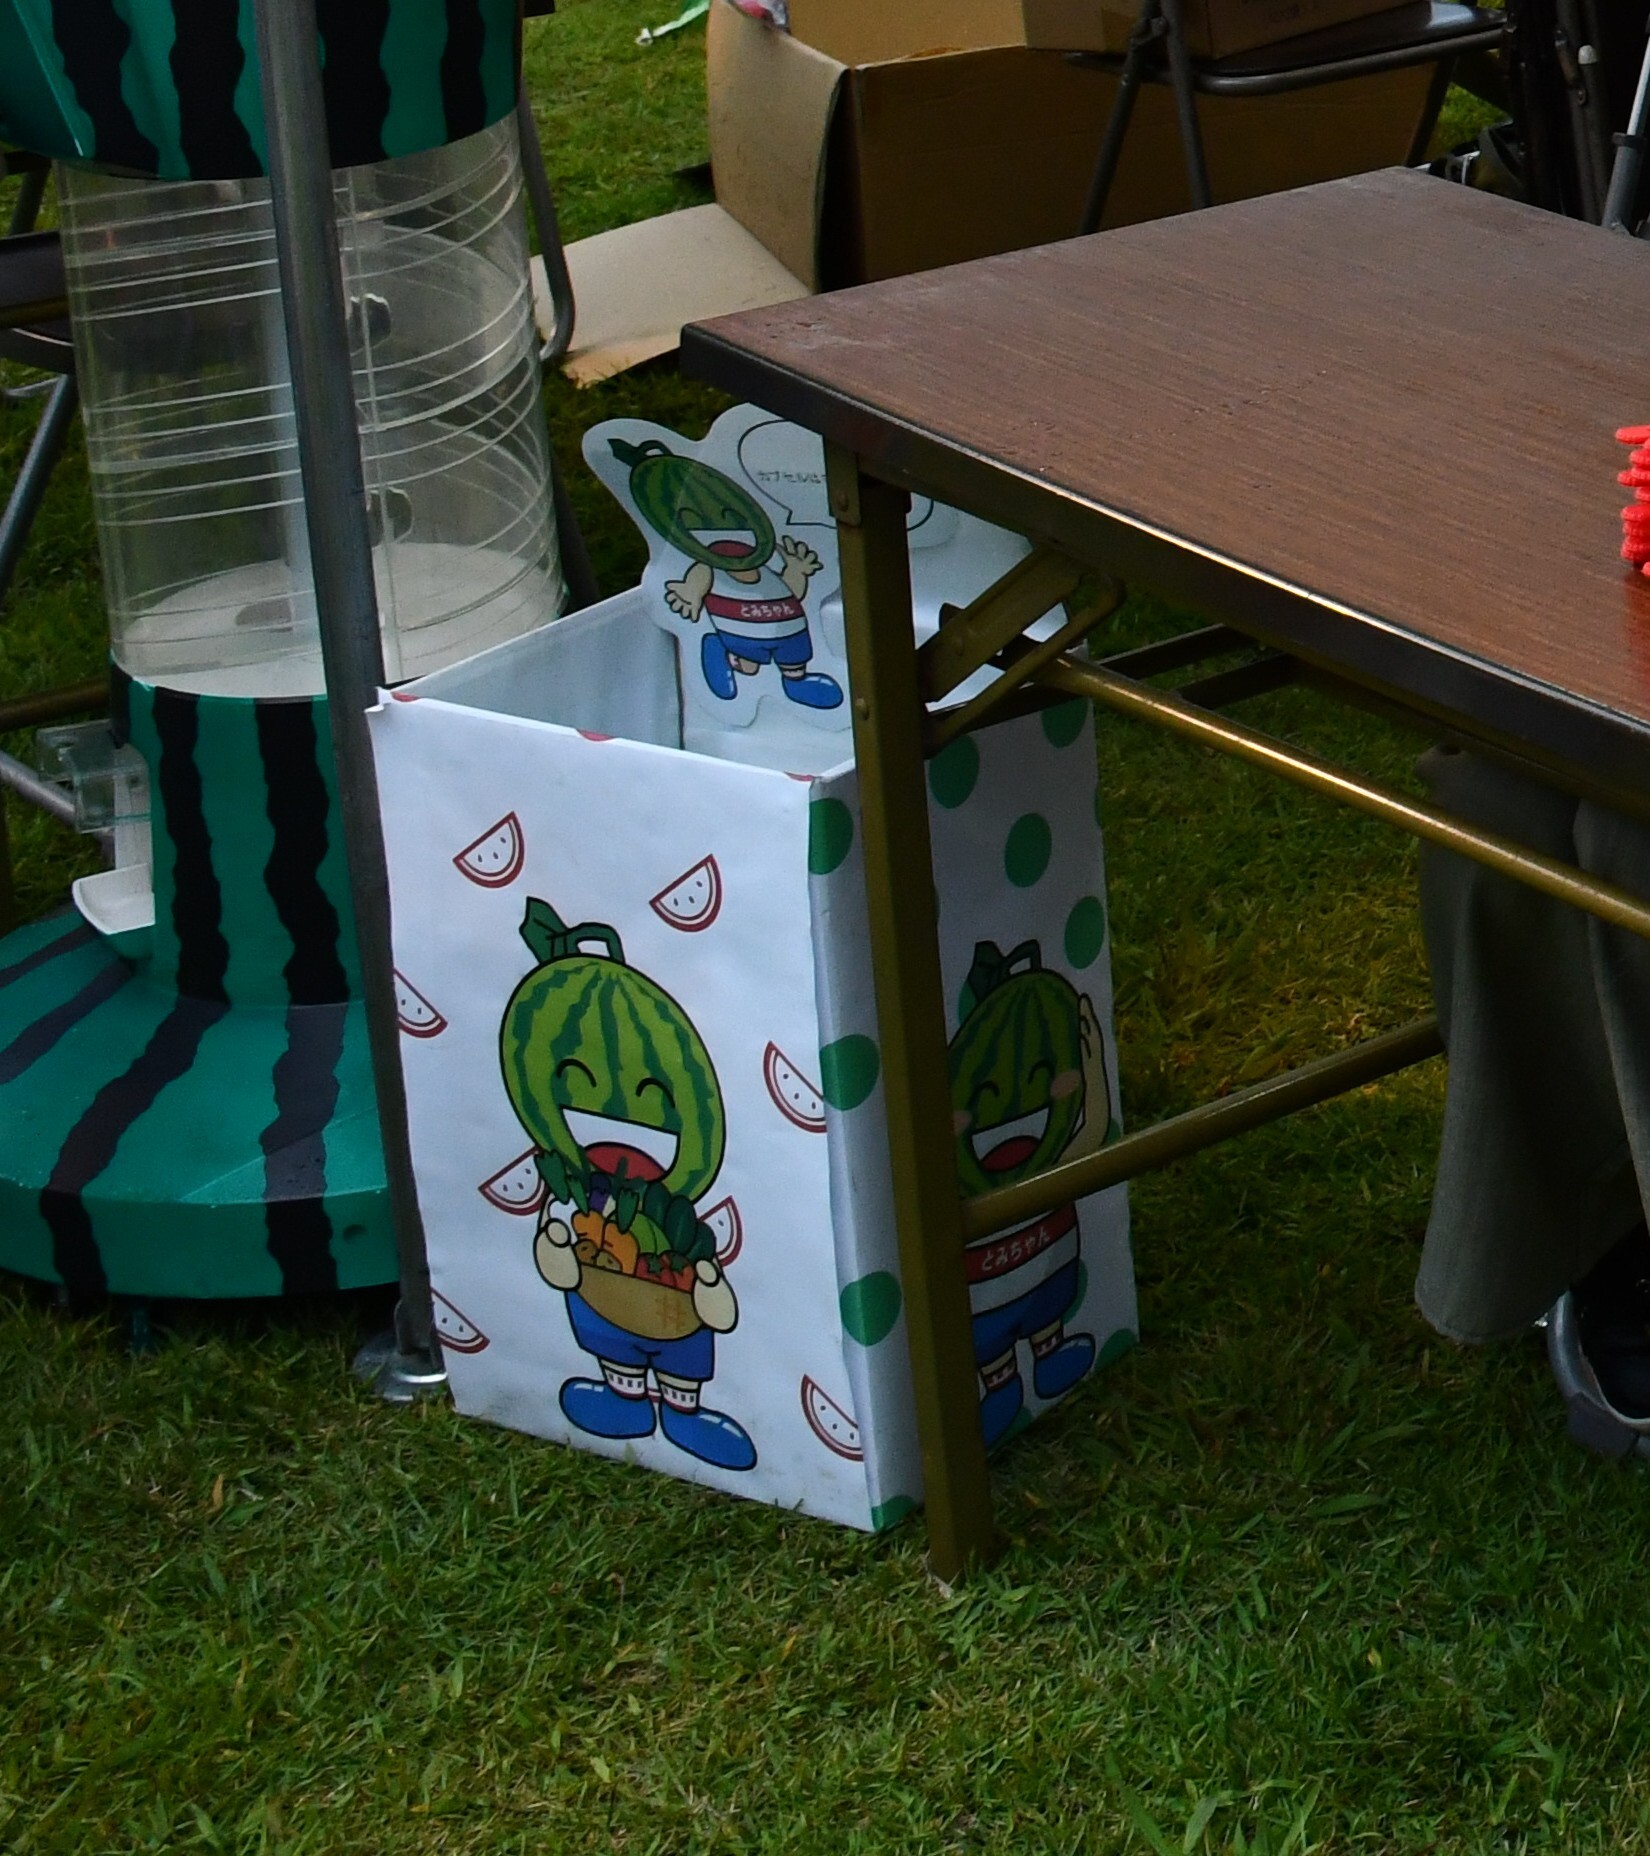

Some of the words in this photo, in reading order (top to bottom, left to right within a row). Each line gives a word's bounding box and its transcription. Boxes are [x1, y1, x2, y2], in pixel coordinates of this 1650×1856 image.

[740, 604, 795, 618] とみちゃん
[981, 1225, 1051, 1272] とみちゃん
